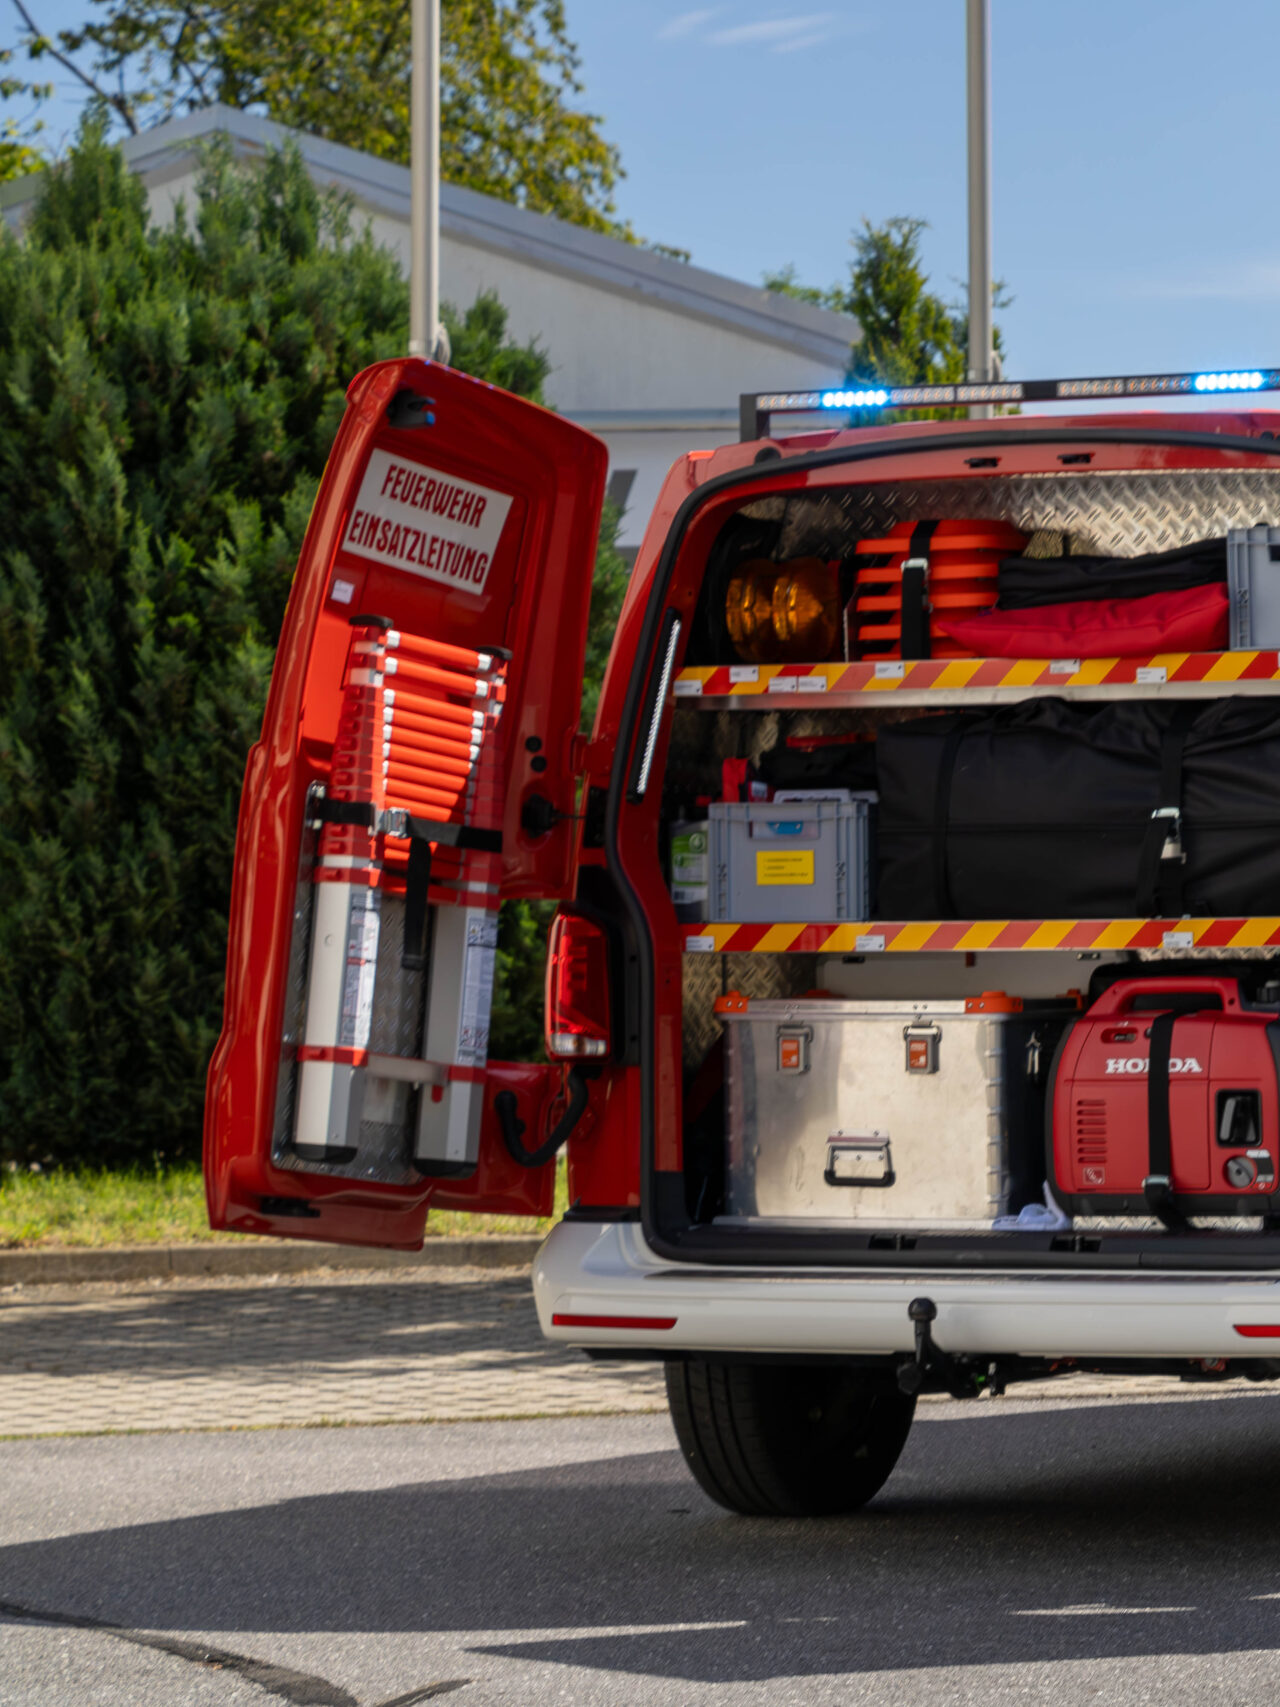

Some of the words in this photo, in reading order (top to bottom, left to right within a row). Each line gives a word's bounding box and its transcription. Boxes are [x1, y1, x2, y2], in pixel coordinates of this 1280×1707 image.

[380, 463, 488, 529] FEUERWEHR
[347, 509, 490, 585] EINSATZLEITUNG
[1105, 1057, 1203, 1074] HODA
